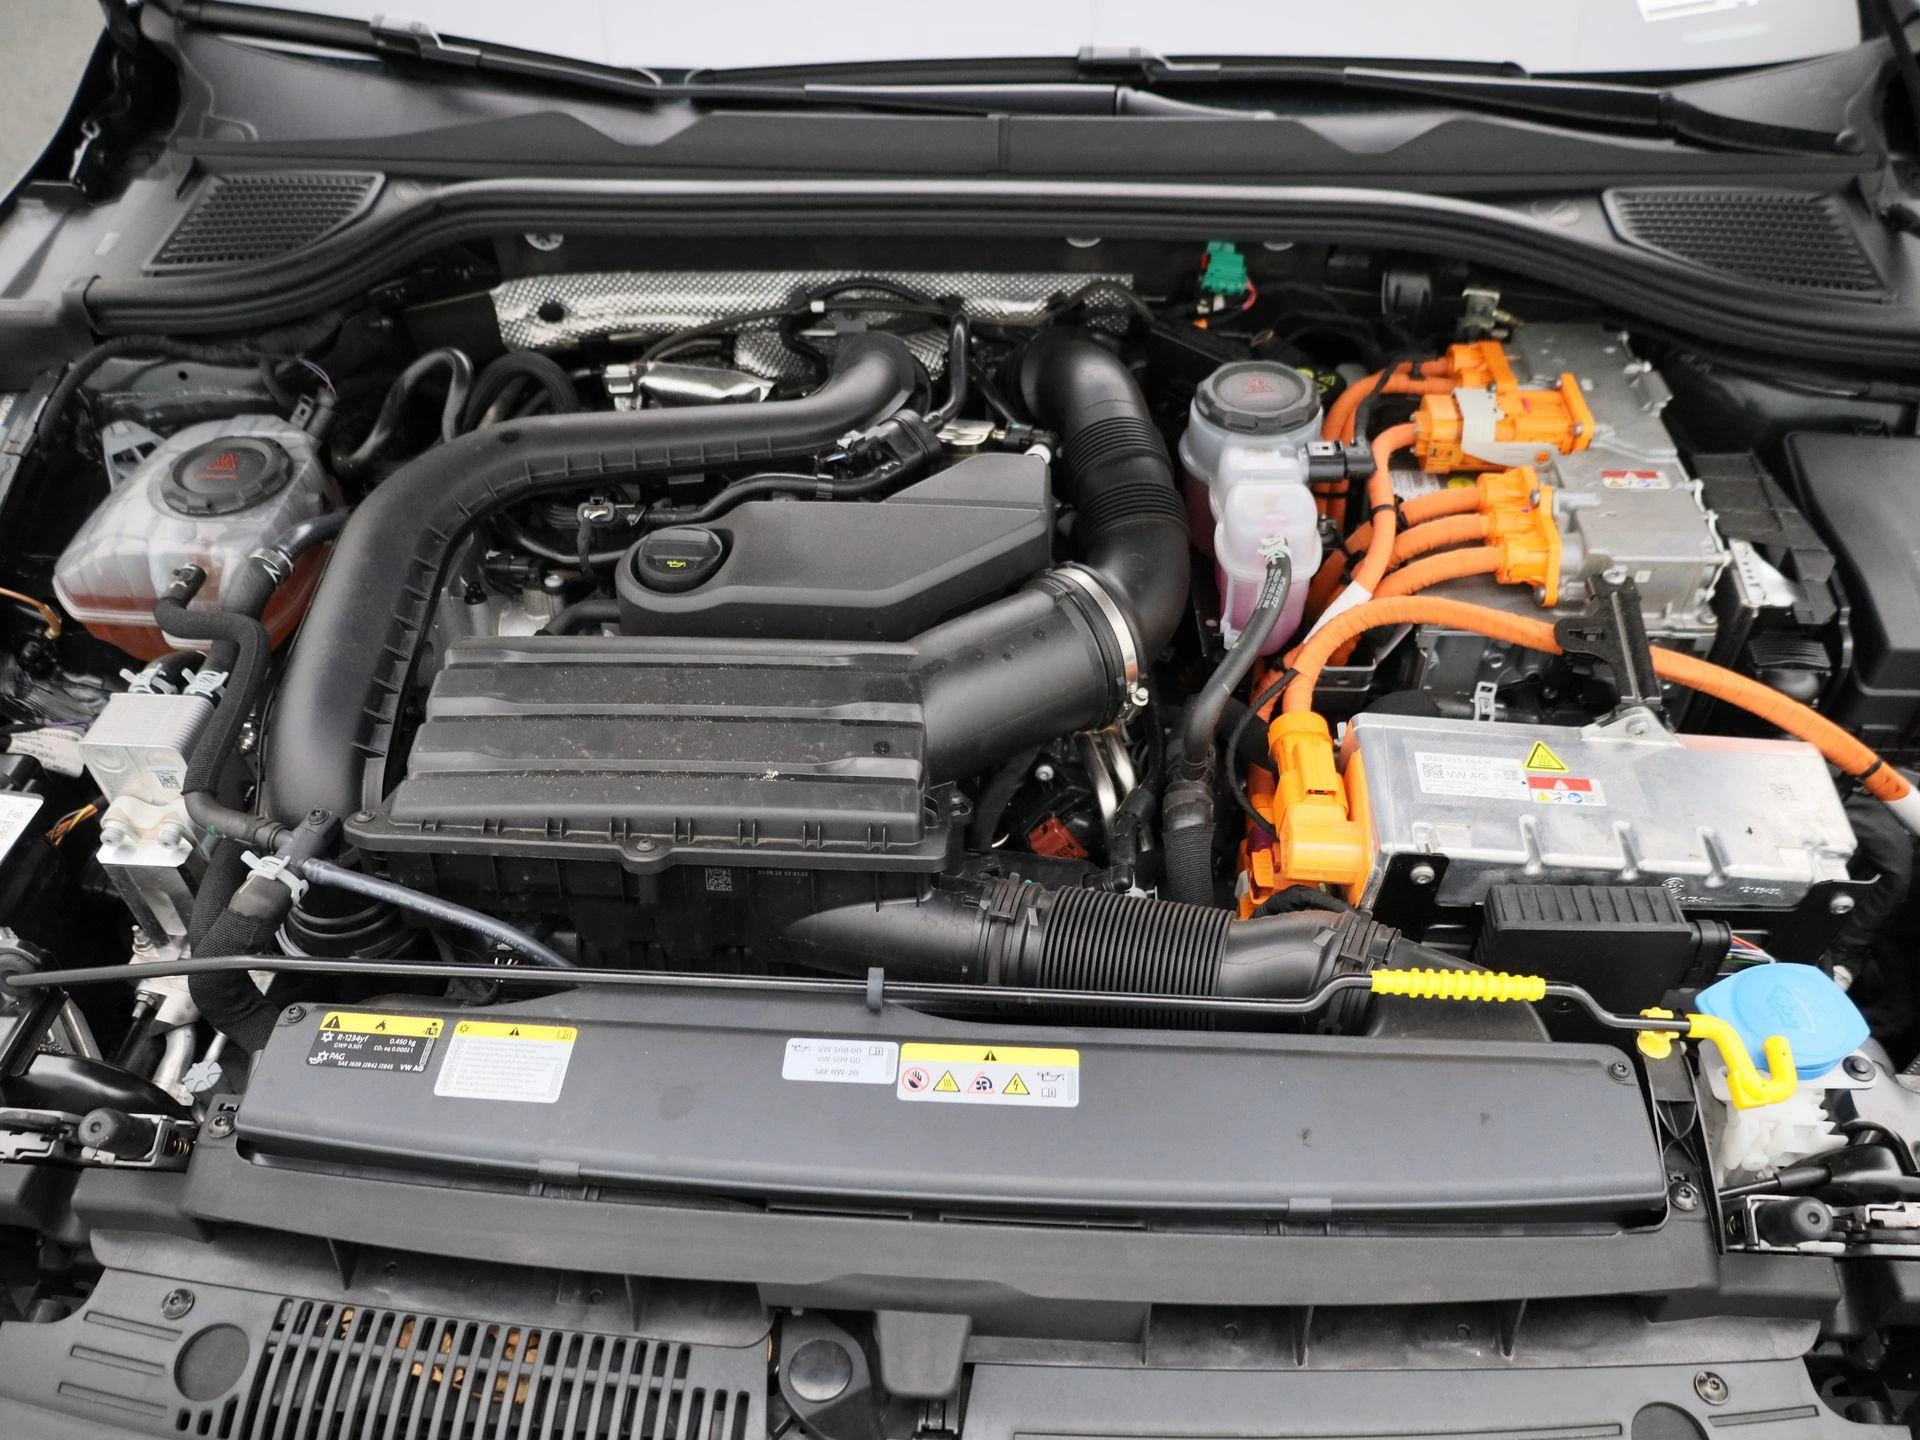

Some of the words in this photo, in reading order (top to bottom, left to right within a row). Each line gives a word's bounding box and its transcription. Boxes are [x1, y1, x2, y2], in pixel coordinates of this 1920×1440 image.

[337, 1034, 369, 1043] R-1234yf
[816, 1045, 831, 1053] VW
[328, 1052, 345, 1060] PAG
